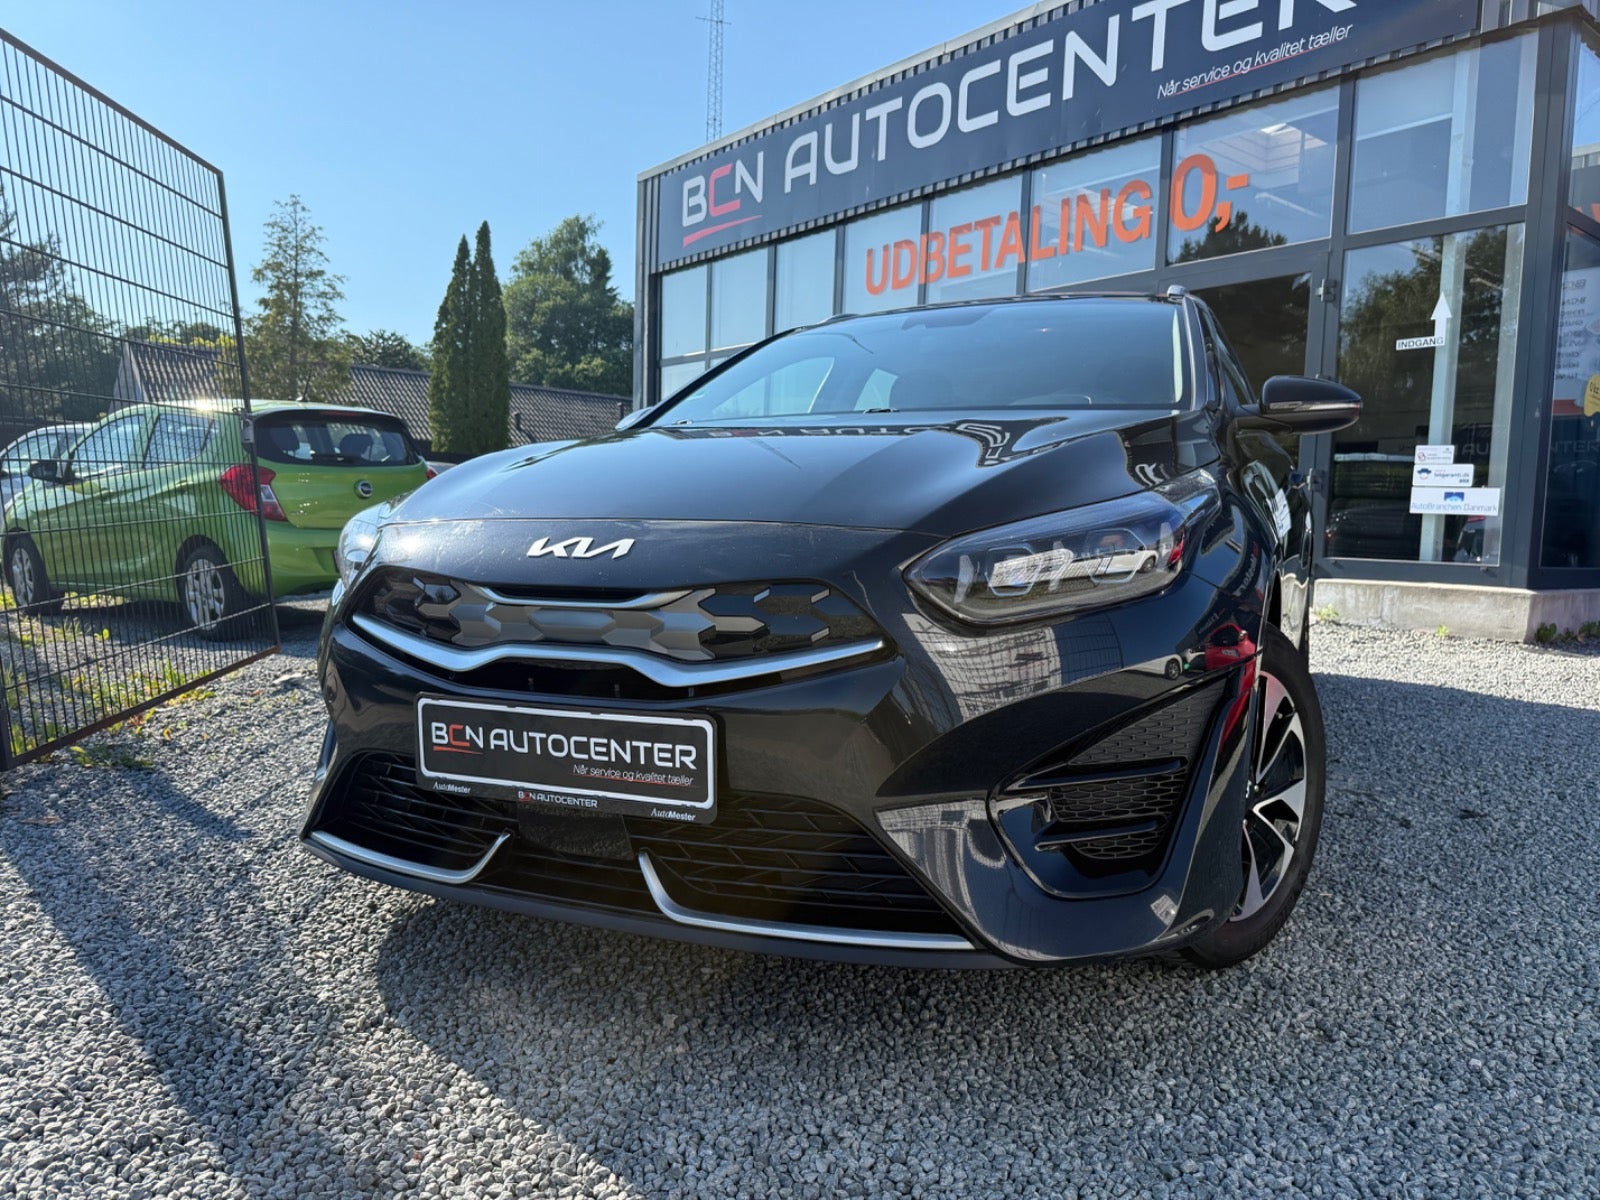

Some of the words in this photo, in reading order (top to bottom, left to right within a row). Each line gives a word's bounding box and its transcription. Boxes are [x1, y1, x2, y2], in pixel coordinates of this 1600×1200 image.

[1157, 80, 1180, 99] Når
[1182, 66, 1230, 92] service
[1232, 56, 1252, 75] og
[1254, 37, 1307, 66] kvalitet
[1308, 24, 1354, 49] tæller
[682, 151, 764, 227] BCN
[784, 0, 1357, 193] AUTOCENTE
[865, 179, 1153, 296] UDBETALING
[1397, 336, 1444, 351] INDGANG
[1463, 503, 1499, 514] Danmark
[526, 536, 636, 559] KIA
[431, 722, 484, 748] BCN
[490, 728, 697, 770] AUTOCENTER
[573, 764, 588, 775] Når
[590, 767, 621, 777] service
[622, 770, 635, 782] og
[636, 771, 666, 783] kvalitet
[667, 773, 694, 786] tæller
[433, 781, 471, 794] AutoMester
[536, 792, 598, 808] AUTOCENTER
[650, 807, 697, 821] AutoMester
